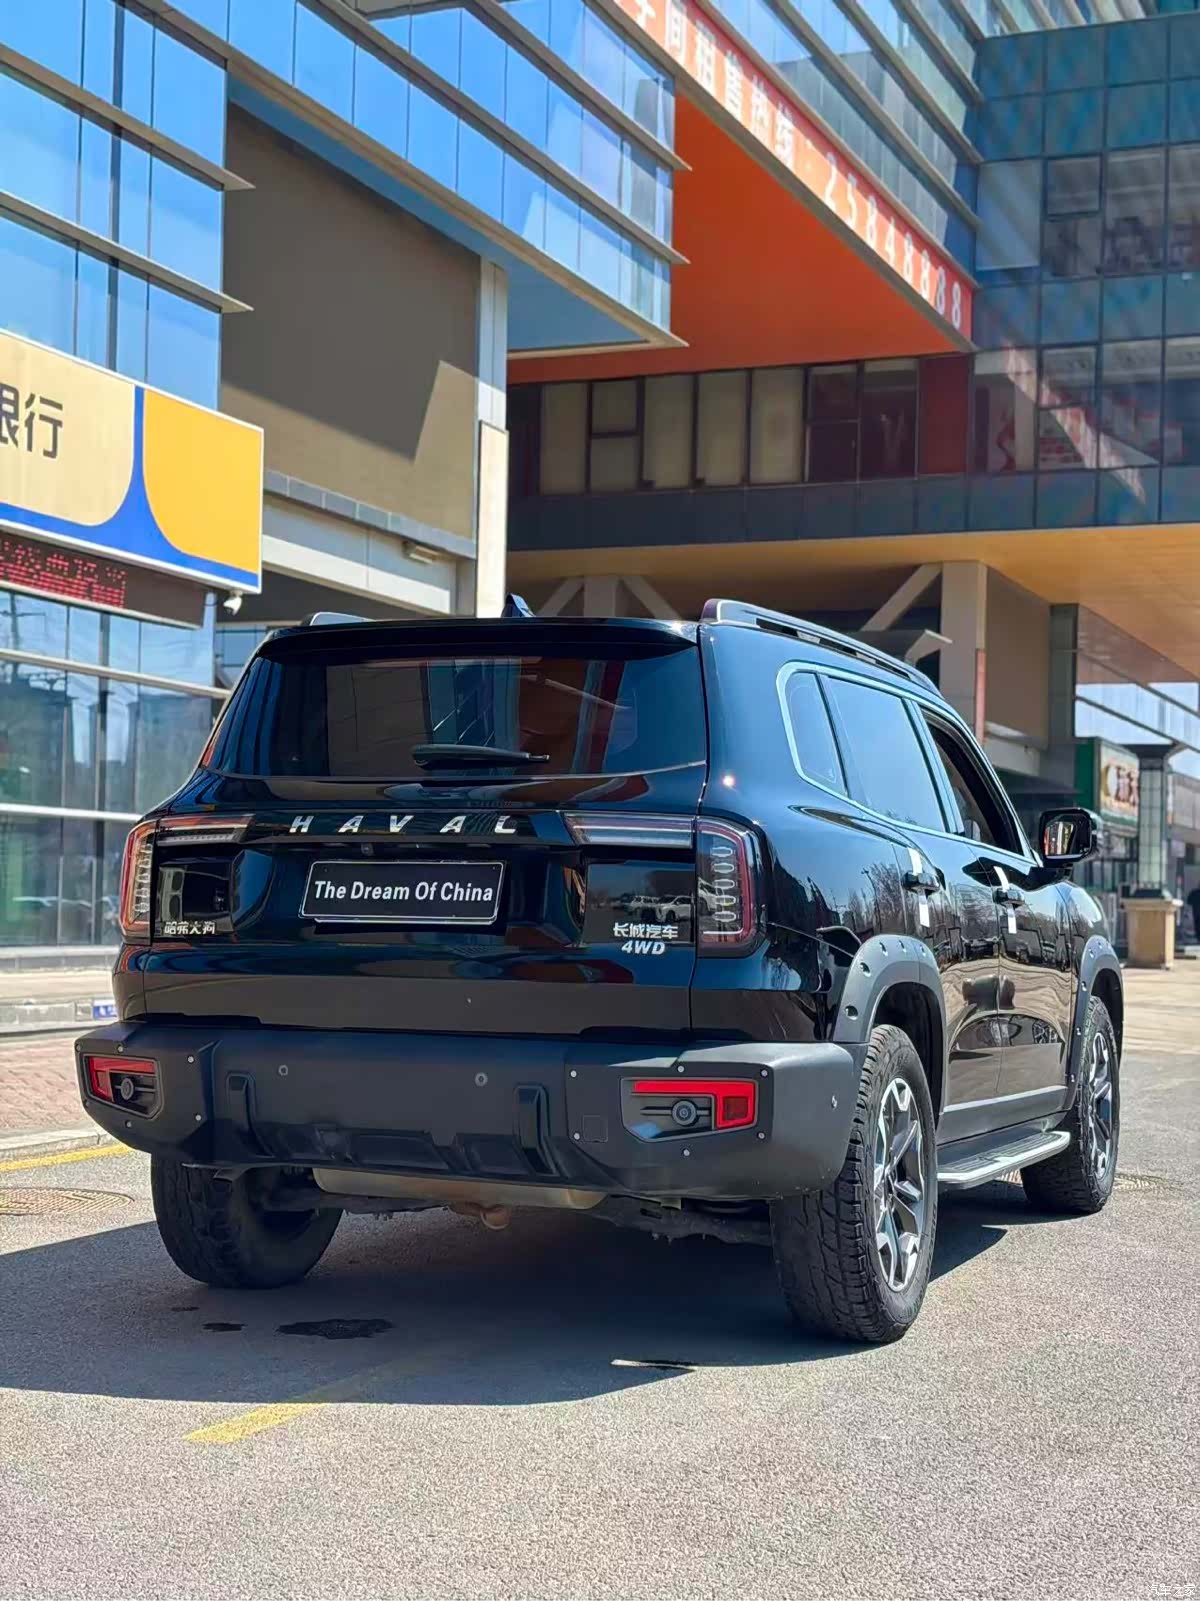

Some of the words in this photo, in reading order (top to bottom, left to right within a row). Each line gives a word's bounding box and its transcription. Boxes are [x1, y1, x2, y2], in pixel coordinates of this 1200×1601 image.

[289, 815, 517, 834] HAVAL
[314, 880, 347, 899] The
[350, 881, 410, 900] Dream
[415, 881, 438, 900] Of
[440, 881, 493, 901] China
[164, 920, 216, 935] 哈弗大狗
[613, 922, 678, 939] 长城汽车
[621, 940, 666, 955] 4WD
